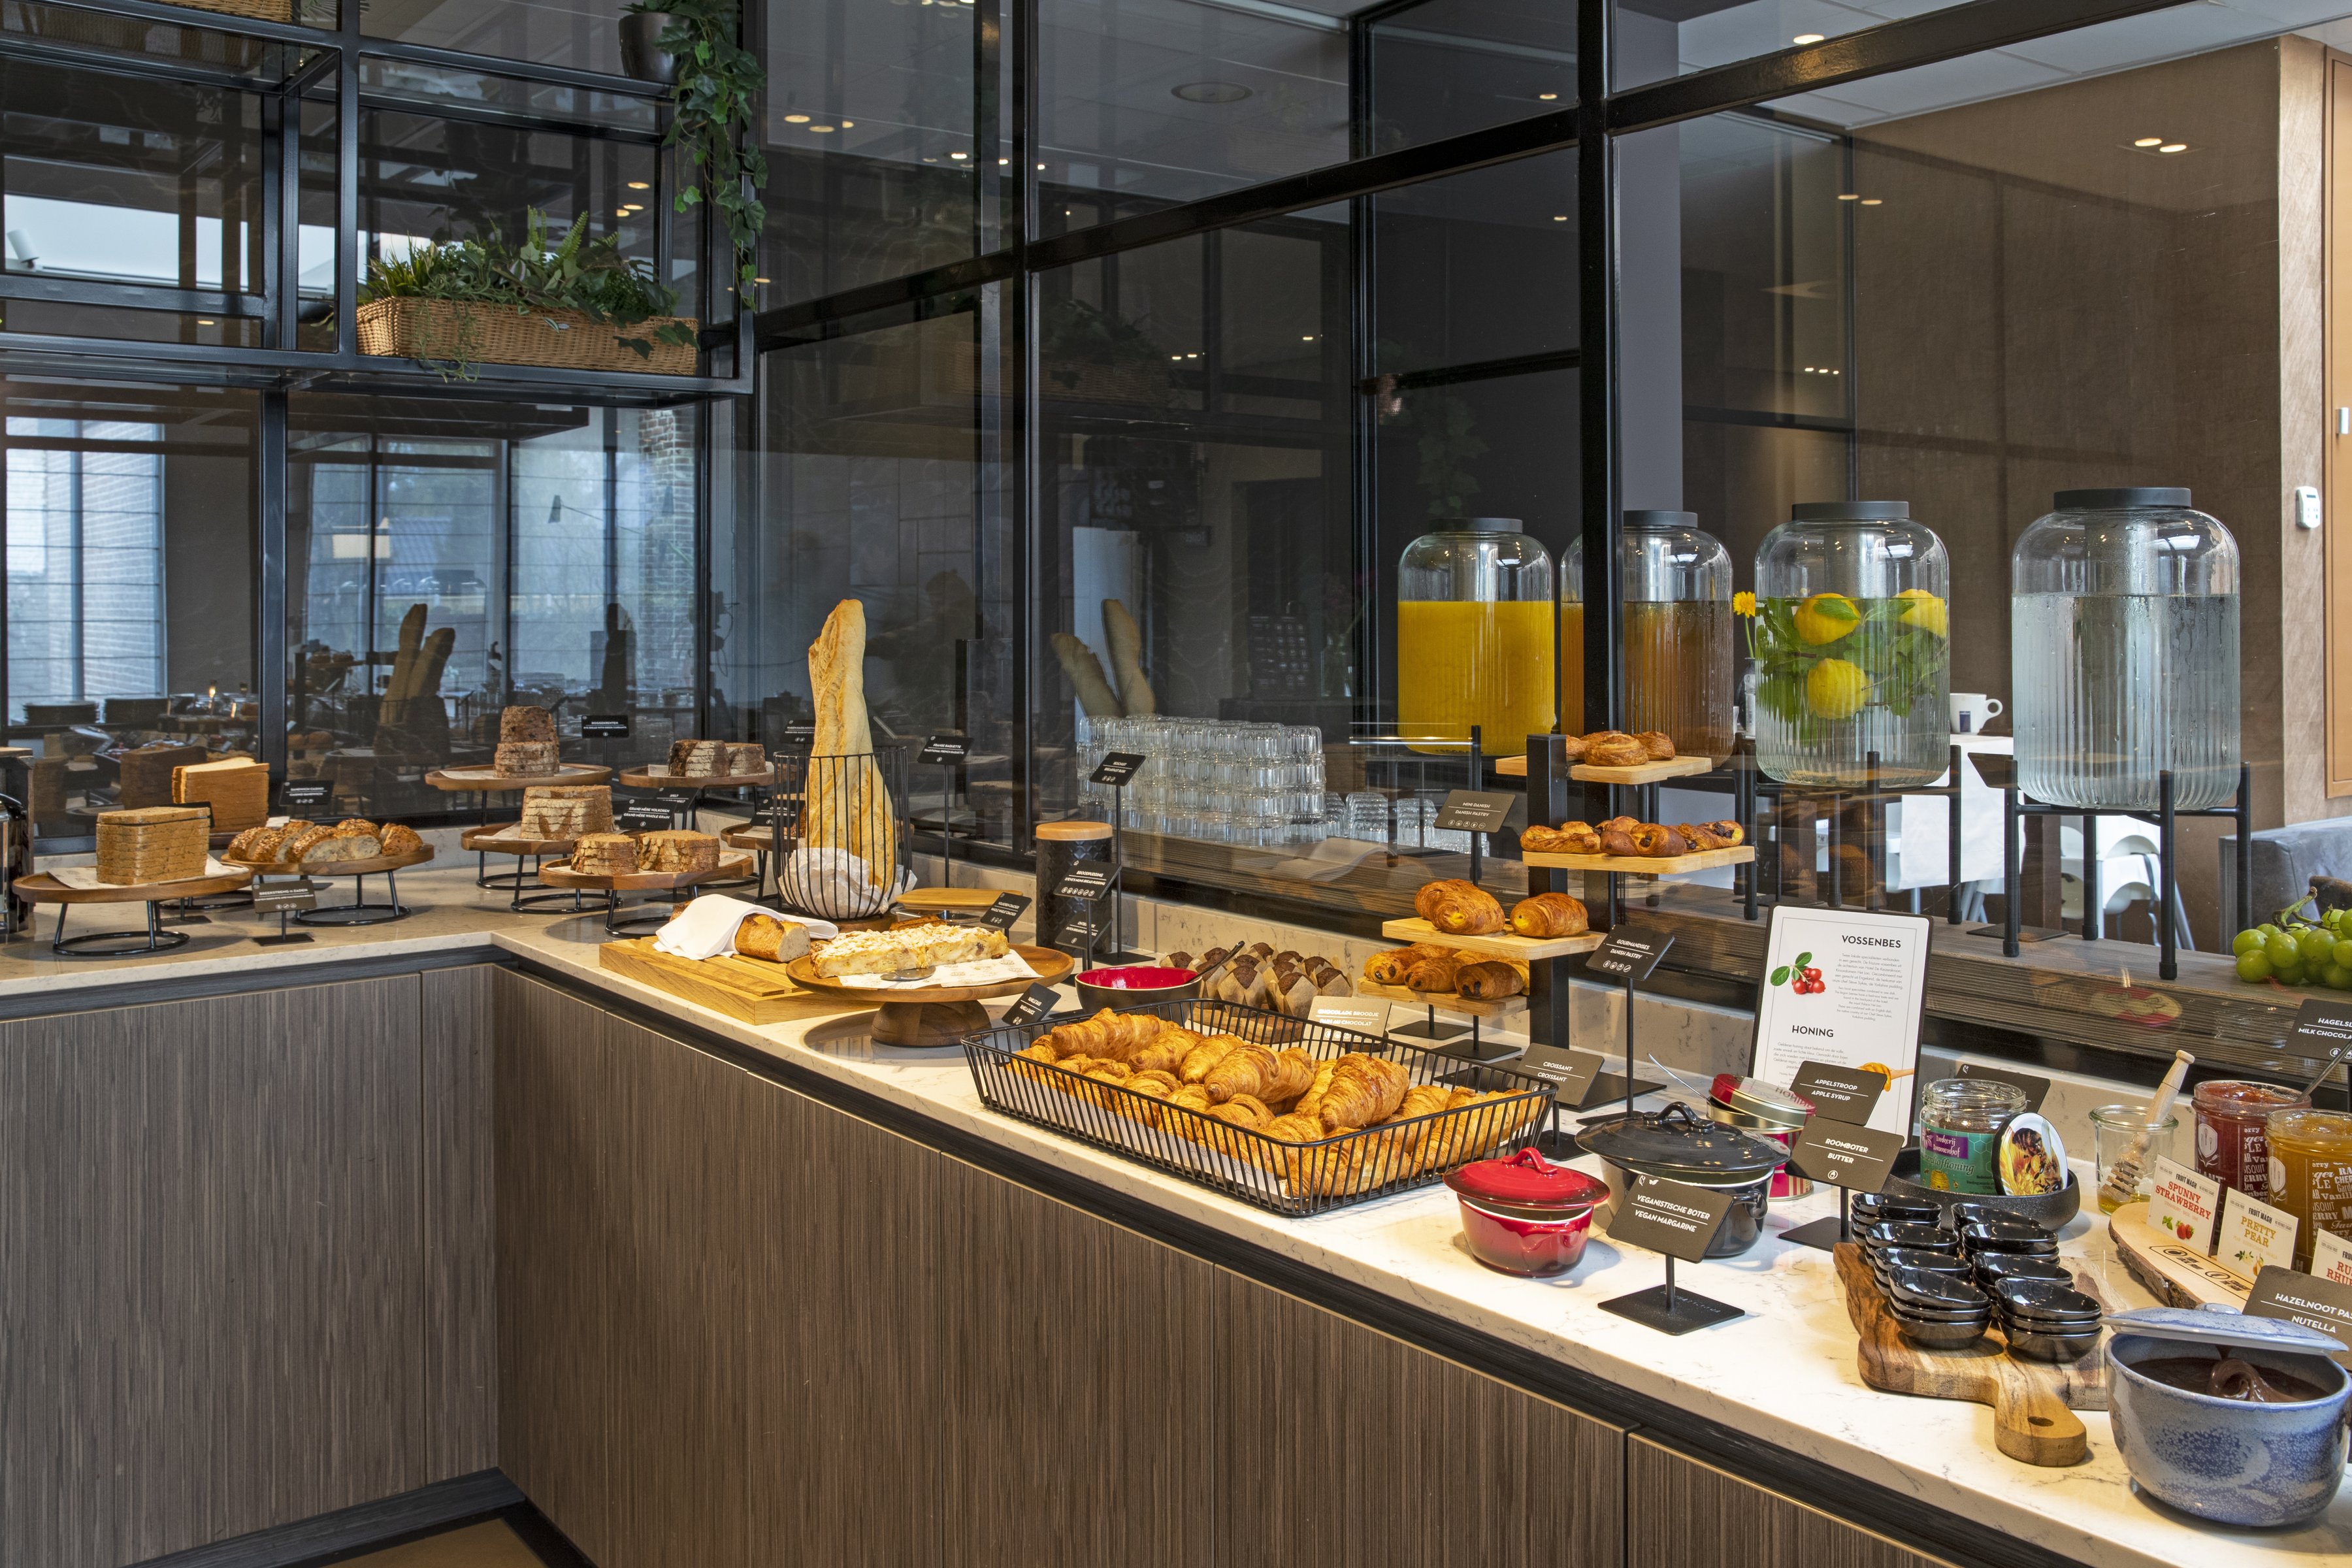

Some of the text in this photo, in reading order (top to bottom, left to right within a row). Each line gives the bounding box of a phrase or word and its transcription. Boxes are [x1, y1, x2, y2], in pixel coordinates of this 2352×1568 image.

[1616, 939, 1650, 950] GOURMANDISES
[1842, 935, 1901, 949] VOSSENBES
[1791, 1025, 1834, 1037] HONING
[1543, 1061, 1573, 1071] CROISSANT
[1537, 1071, 1567, 1082] CROISSANT
[1815, 1079, 1858, 1090] APPELSTROOP
[1825, 1138, 1869, 1153] ROOMBOTER
[1936, 1135, 1956, 1147] Imkerij
[1827, 1152, 1854, 1164] BUTTER
[1933, 1144, 1960, 1158] Immenhof
[2244, 1164, 2264, 1174] ISQUIT
[2176, 1173, 2186, 1183] FRUIT
[2186, 1178, 2197, 1189] MASH
[2168, 1181, 2200, 1203] SPUNNY
[1637, 1194, 1710, 1220] VEGANISTISCHE BOTER
[2155, 1185, 2211, 1220] STRAWBERRY
[2313, 1202, 2334, 1212] ISQUIT
[1635, 1209, 1697, 1233] VEGAN MARGARINE
[2249, 1207, 2272, 1224] FRUIT MASH
[2241, 1216, 2276, 1239] PRETTY
[2244, 1228, 2269, 1248] PEAR
[2337, 1261, 2352, 1277] RU
[2275, 1293, 2337, 1315] HAZELNOOT
[2291, 1315, 2336, 1333] NUTELLA
